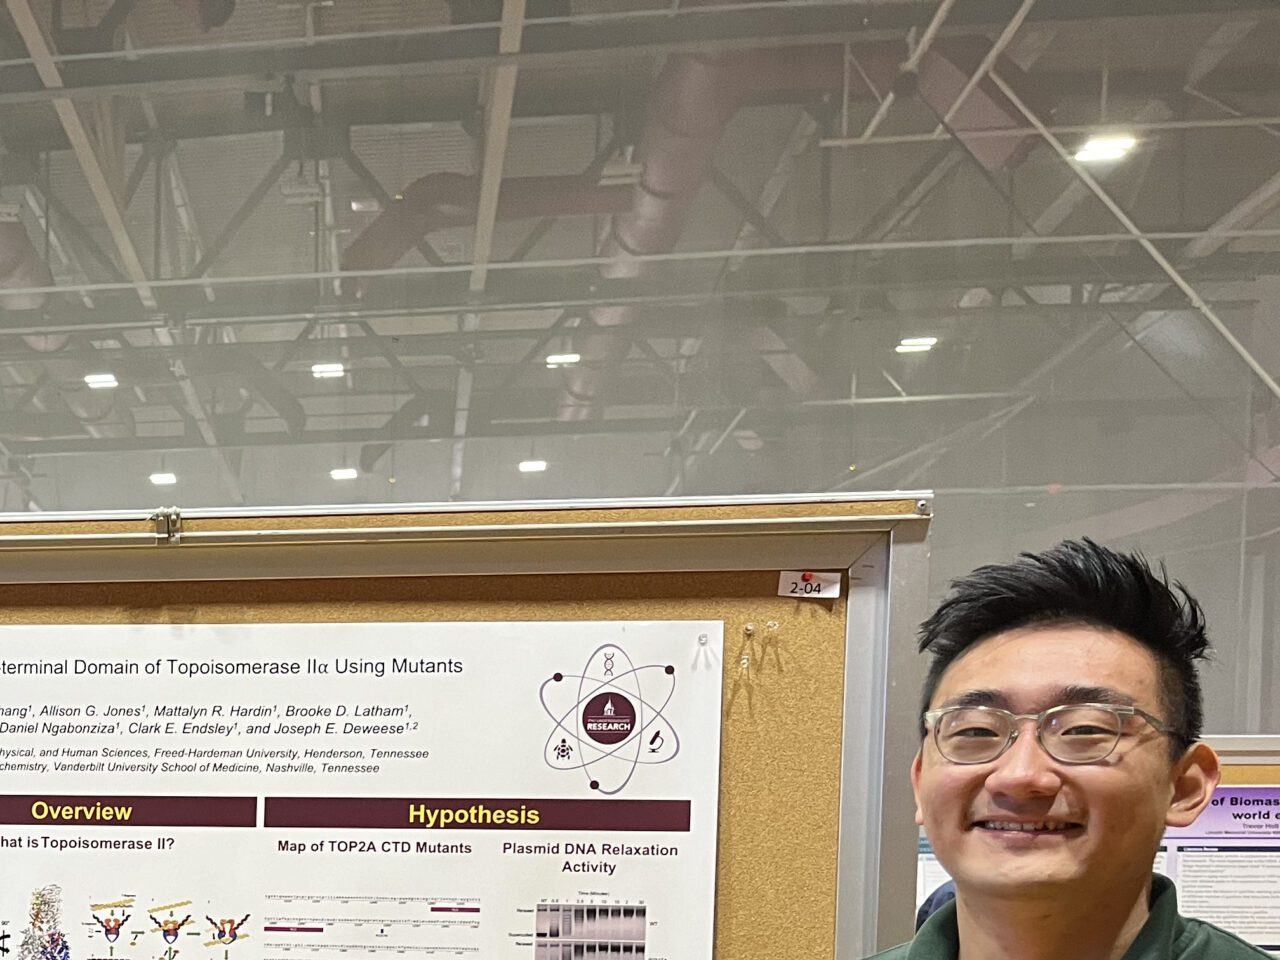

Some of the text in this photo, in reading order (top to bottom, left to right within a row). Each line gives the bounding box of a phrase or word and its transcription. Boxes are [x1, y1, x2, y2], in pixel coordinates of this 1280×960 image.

[789, 581, 822, 595] 2-04
[74, 659, 138, 674] Domain
[144, 658, 162, 674] of
[166, 659, 300, 678] Topoisomerase
[335, 658, 384, 677] Using
[392, 658, 463, 673] Mutants
[39, 704, 80, 716] Allison
[153, 705, 207, 719] Mattalyn
[285, 705, 331, 716] Brooke
[128, 721, 161, 734] Clark
[245, 722, 271, 734] and
[273, 722, 321, 737] Joseph
[586, 722, 631, 731] RESEARCH
[39, 747, 59, 757] and
[60, 747, 98, 757] Human
[101, 747, 150, 758] Sciences,
[153, 747, 242, 758] Freed-Hardeman
[245, 748, 300, 760] University,
[303, 748, 365, 759] Henderson,
[370, 748, 429, 758] Tennessee
[53, 761, 105, 771] Vanderbilt
[107, 761, 158, 774] University
[160, 761, 197, 772] School
[199, 762, 211, 772] of
[212, 762, 261, 774] Medicine,
[265, 762, 316, 774] Nashville,
[321, 762, 379, 773] Tennessee
[1211, 796, 1280, 807] of Biomas
[31, 801, 132, 820] Overview
[409, 804, 539, 827] Hypothesis
[1231, 810, 1270, 820] world
[27, 836, 38, 848] is
[40, 836, 152, 851] Topoisomerase
[157, 837, 174, 849] II?
[277, 840, 471, 854] Map of TOP2A CTD Mutants
[502, 842, 678, 856] Plasmid DNA Relaxation
[561, 860, 616, 875] Activity
